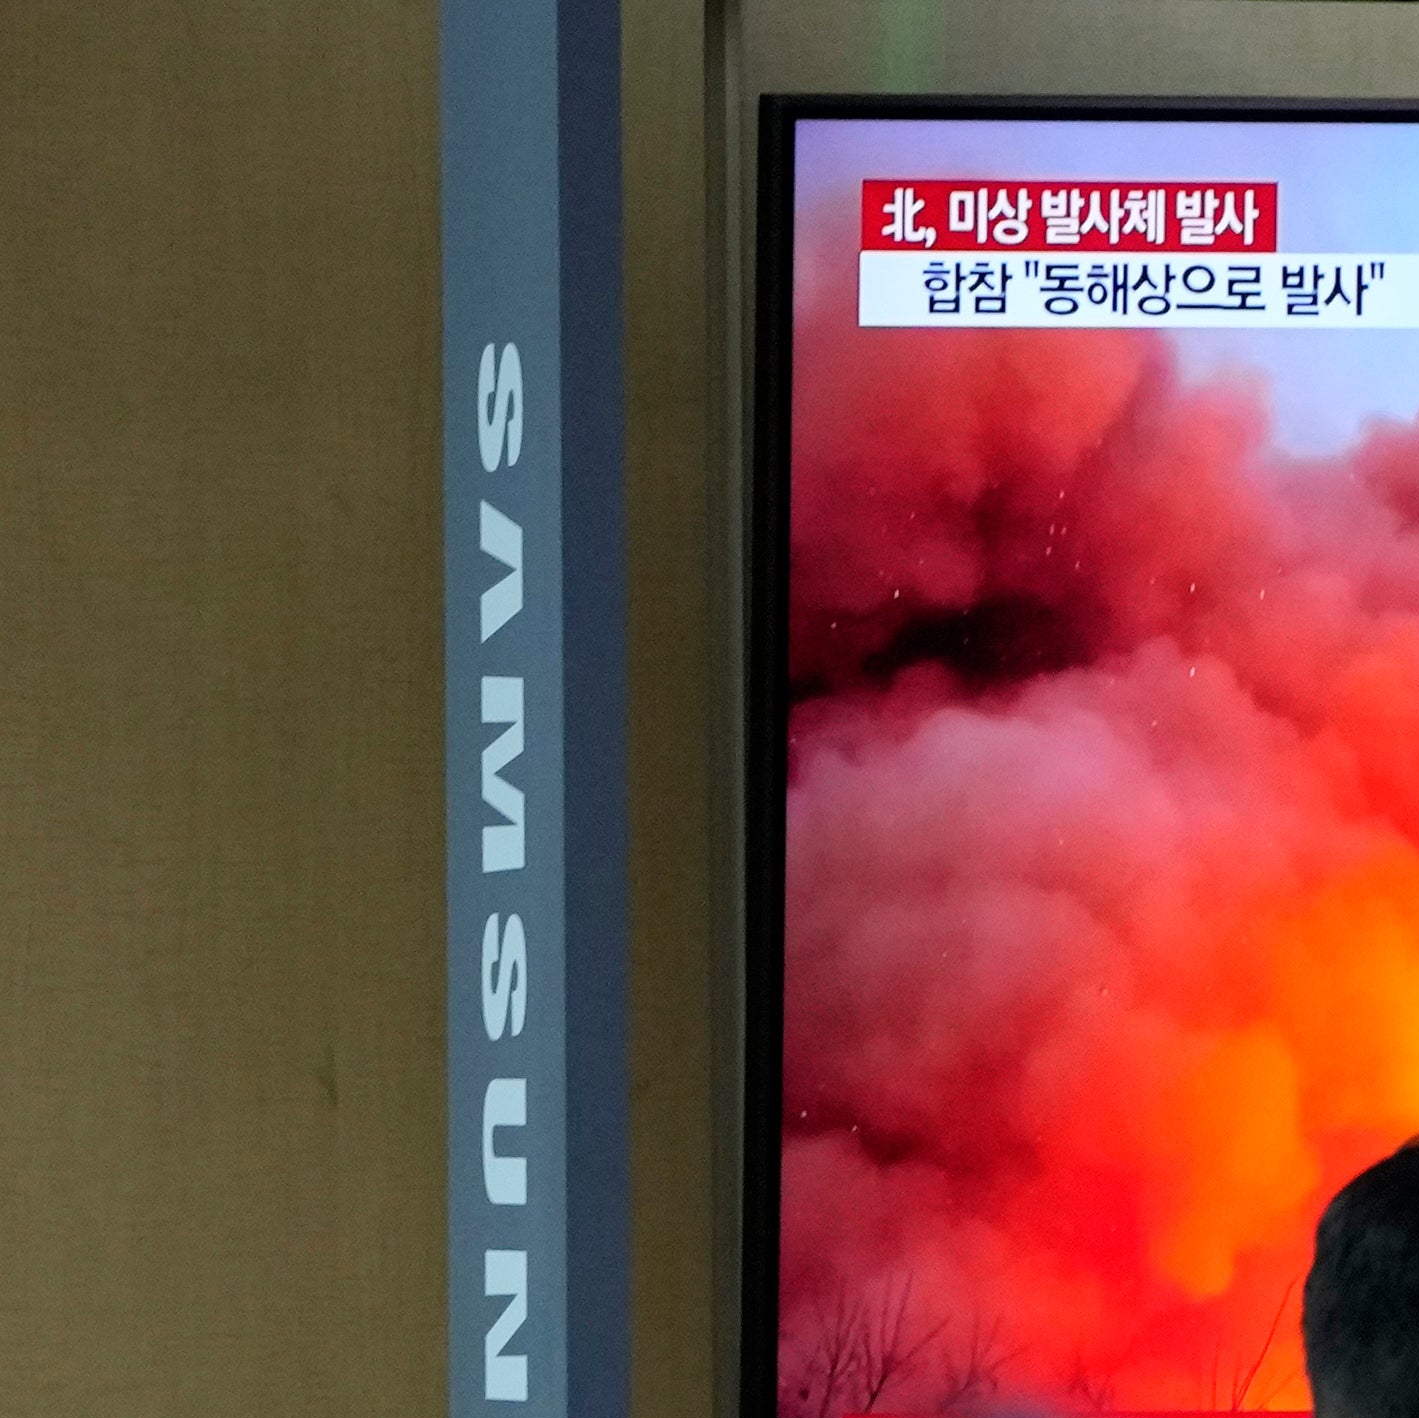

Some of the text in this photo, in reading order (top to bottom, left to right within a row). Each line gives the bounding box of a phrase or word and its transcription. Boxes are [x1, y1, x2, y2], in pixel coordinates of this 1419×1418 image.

[949, 188, 1030, 246] 미상
[1040, 188, 1166, 244] 발사체
[1175, 188, 1258, 245] 발사
[922, 260, 1386, 316] 합참 "동해상으로 발사"
